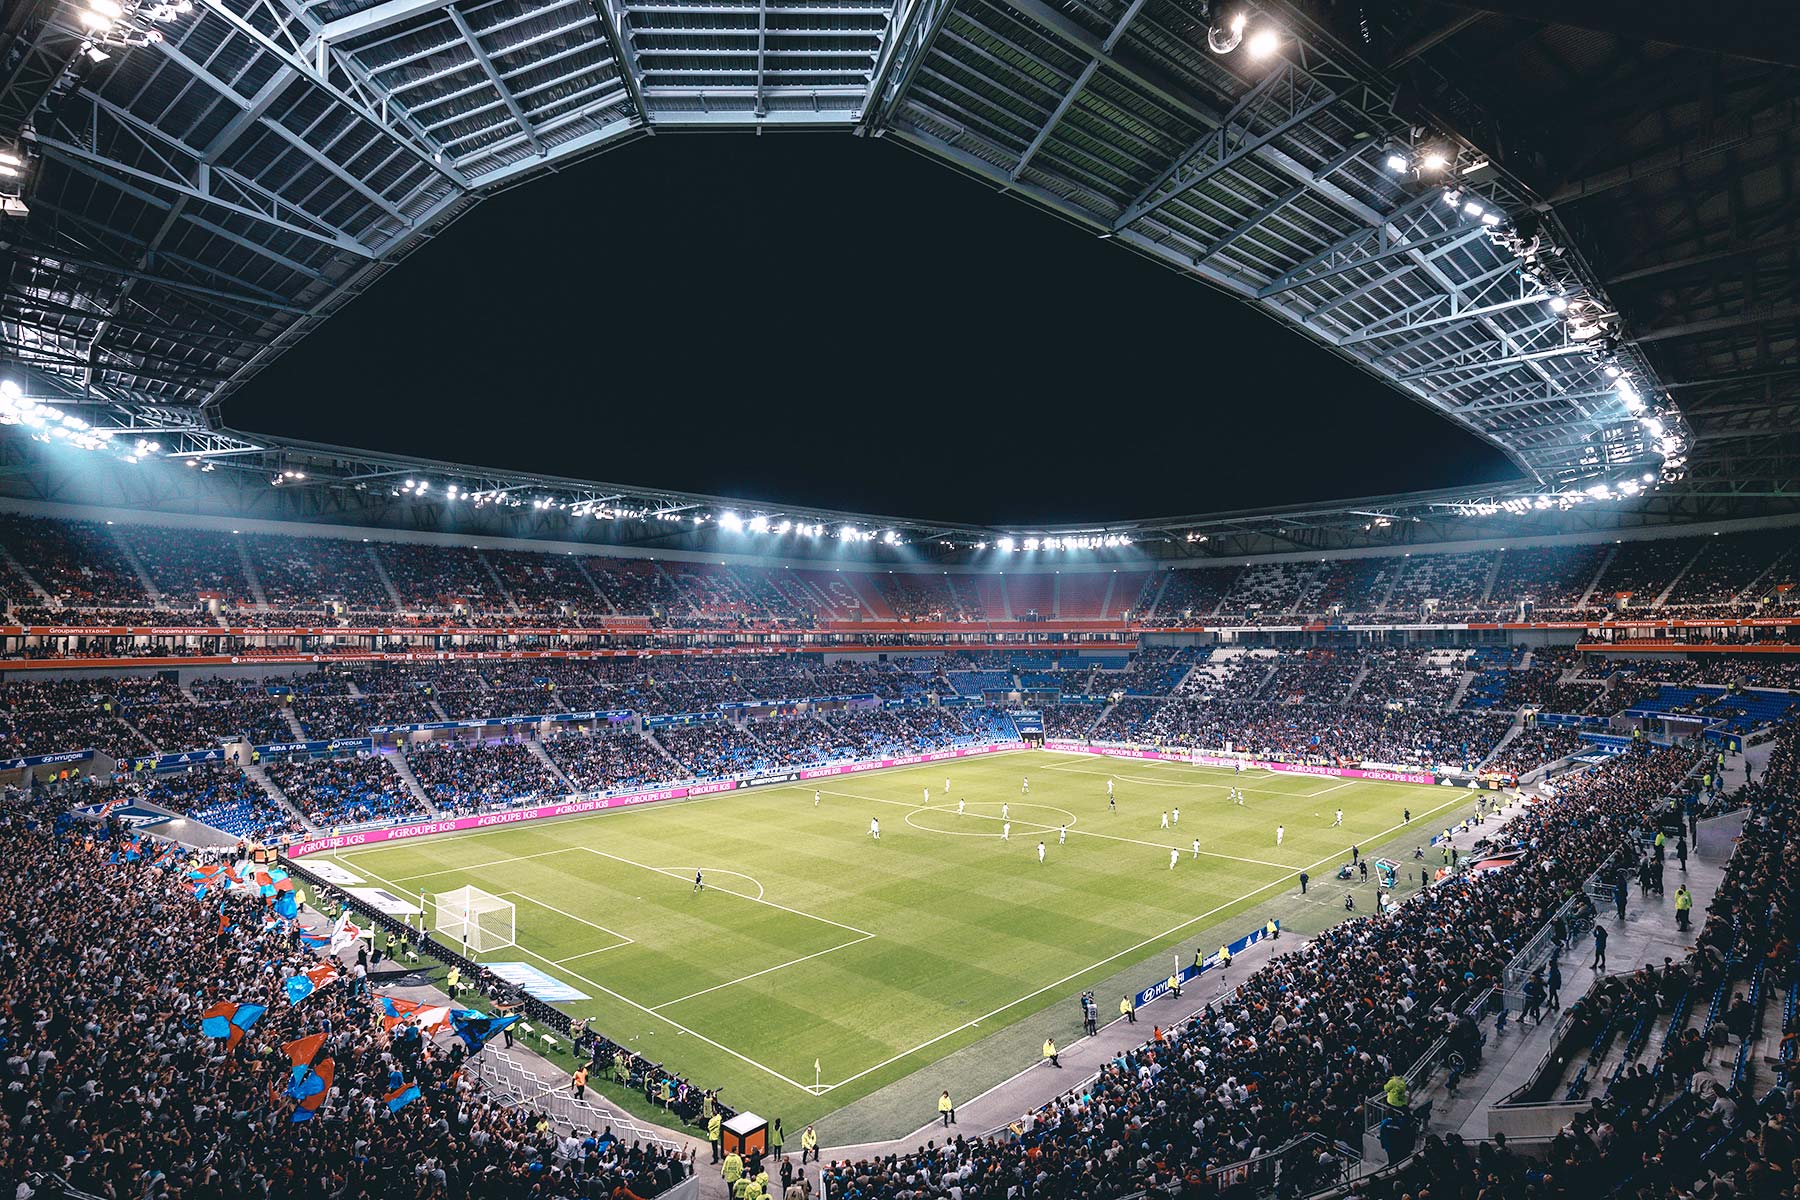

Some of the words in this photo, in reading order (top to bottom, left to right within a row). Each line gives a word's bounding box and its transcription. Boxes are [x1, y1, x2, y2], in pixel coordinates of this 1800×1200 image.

[55, 753, 83, 761] HYUNDAI
[1286, 764, 1326, 775] #GROUPE
[1327, 767, 1342, 776] IGS
[1362, 770, 1406, 782] #GROUPE
[1408, 773, 1424, 783] IGS
[624, 793, 659, 805] #GROUPE
[660, 791, 672, 800] IGS
[555, 802, 594, 814] #GROUPE
[595, 800, 608, 808] IGS
[478, 812, 521, 826] #GROUPE
[523, 810, 538, 819] IGS
[388, 823, 437, 839] #GROUPE
[439, 821, 456, 831] IGS
[346, 834, 365, 844] IGS
[1156, 972, 1185, 996] HYUAI
